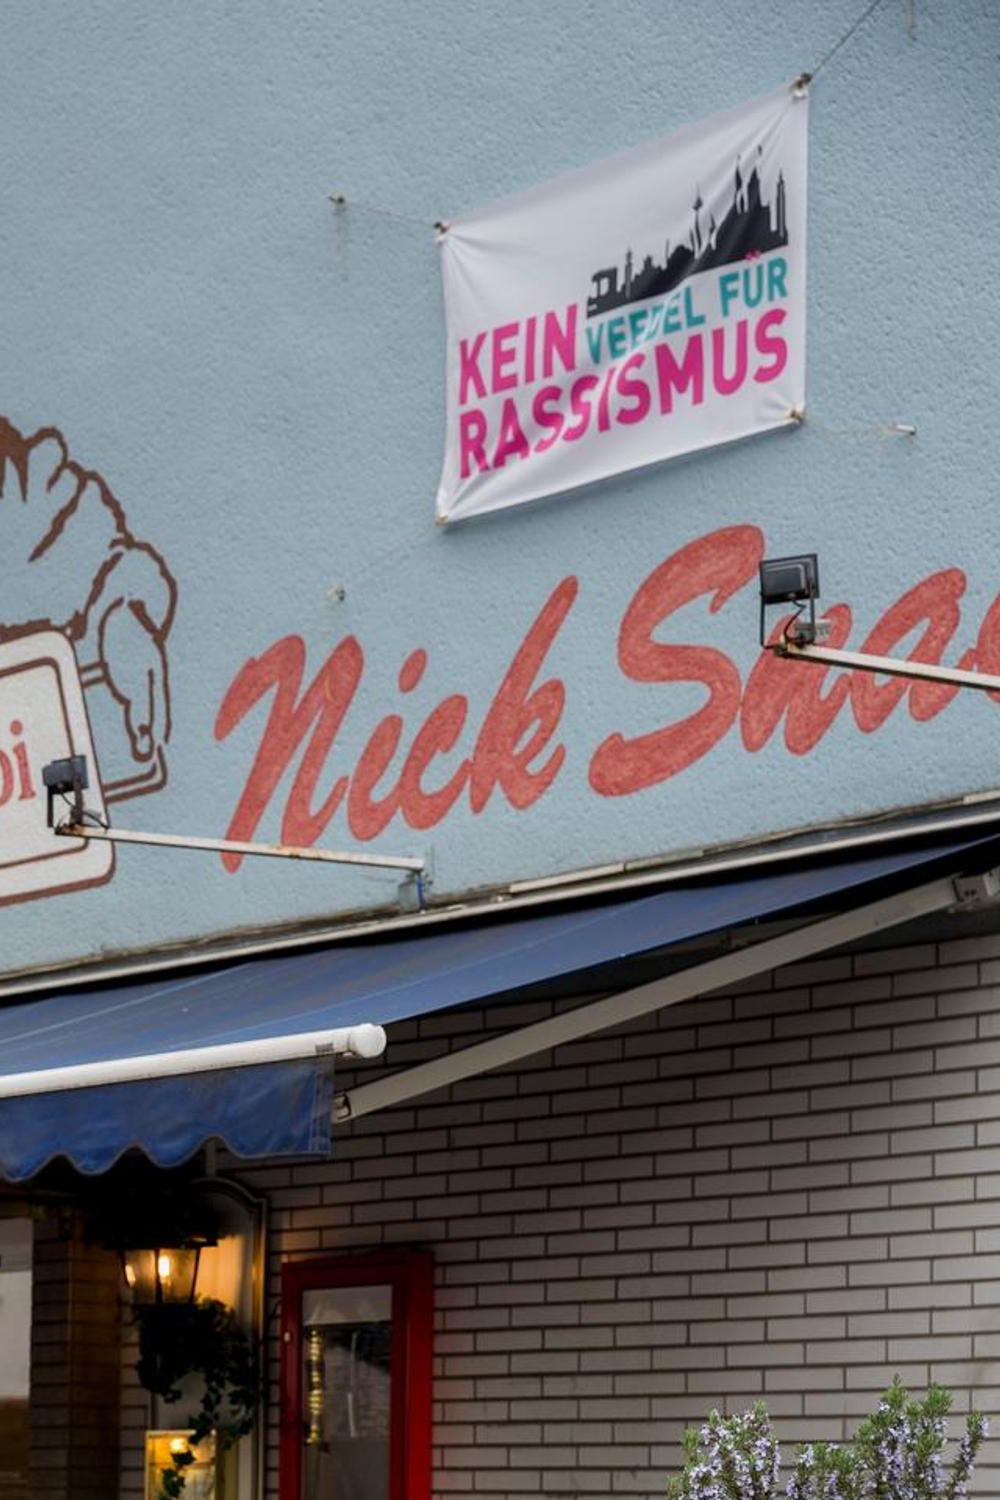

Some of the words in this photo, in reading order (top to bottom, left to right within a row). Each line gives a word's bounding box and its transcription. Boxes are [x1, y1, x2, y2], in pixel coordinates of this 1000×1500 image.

[459, 303, 577, 405] KEIN
[459, 308, 788, 479] RASSISMUS
[213, 575, 579, 874] Nick
[588, 524, 1000, 797] Sna
